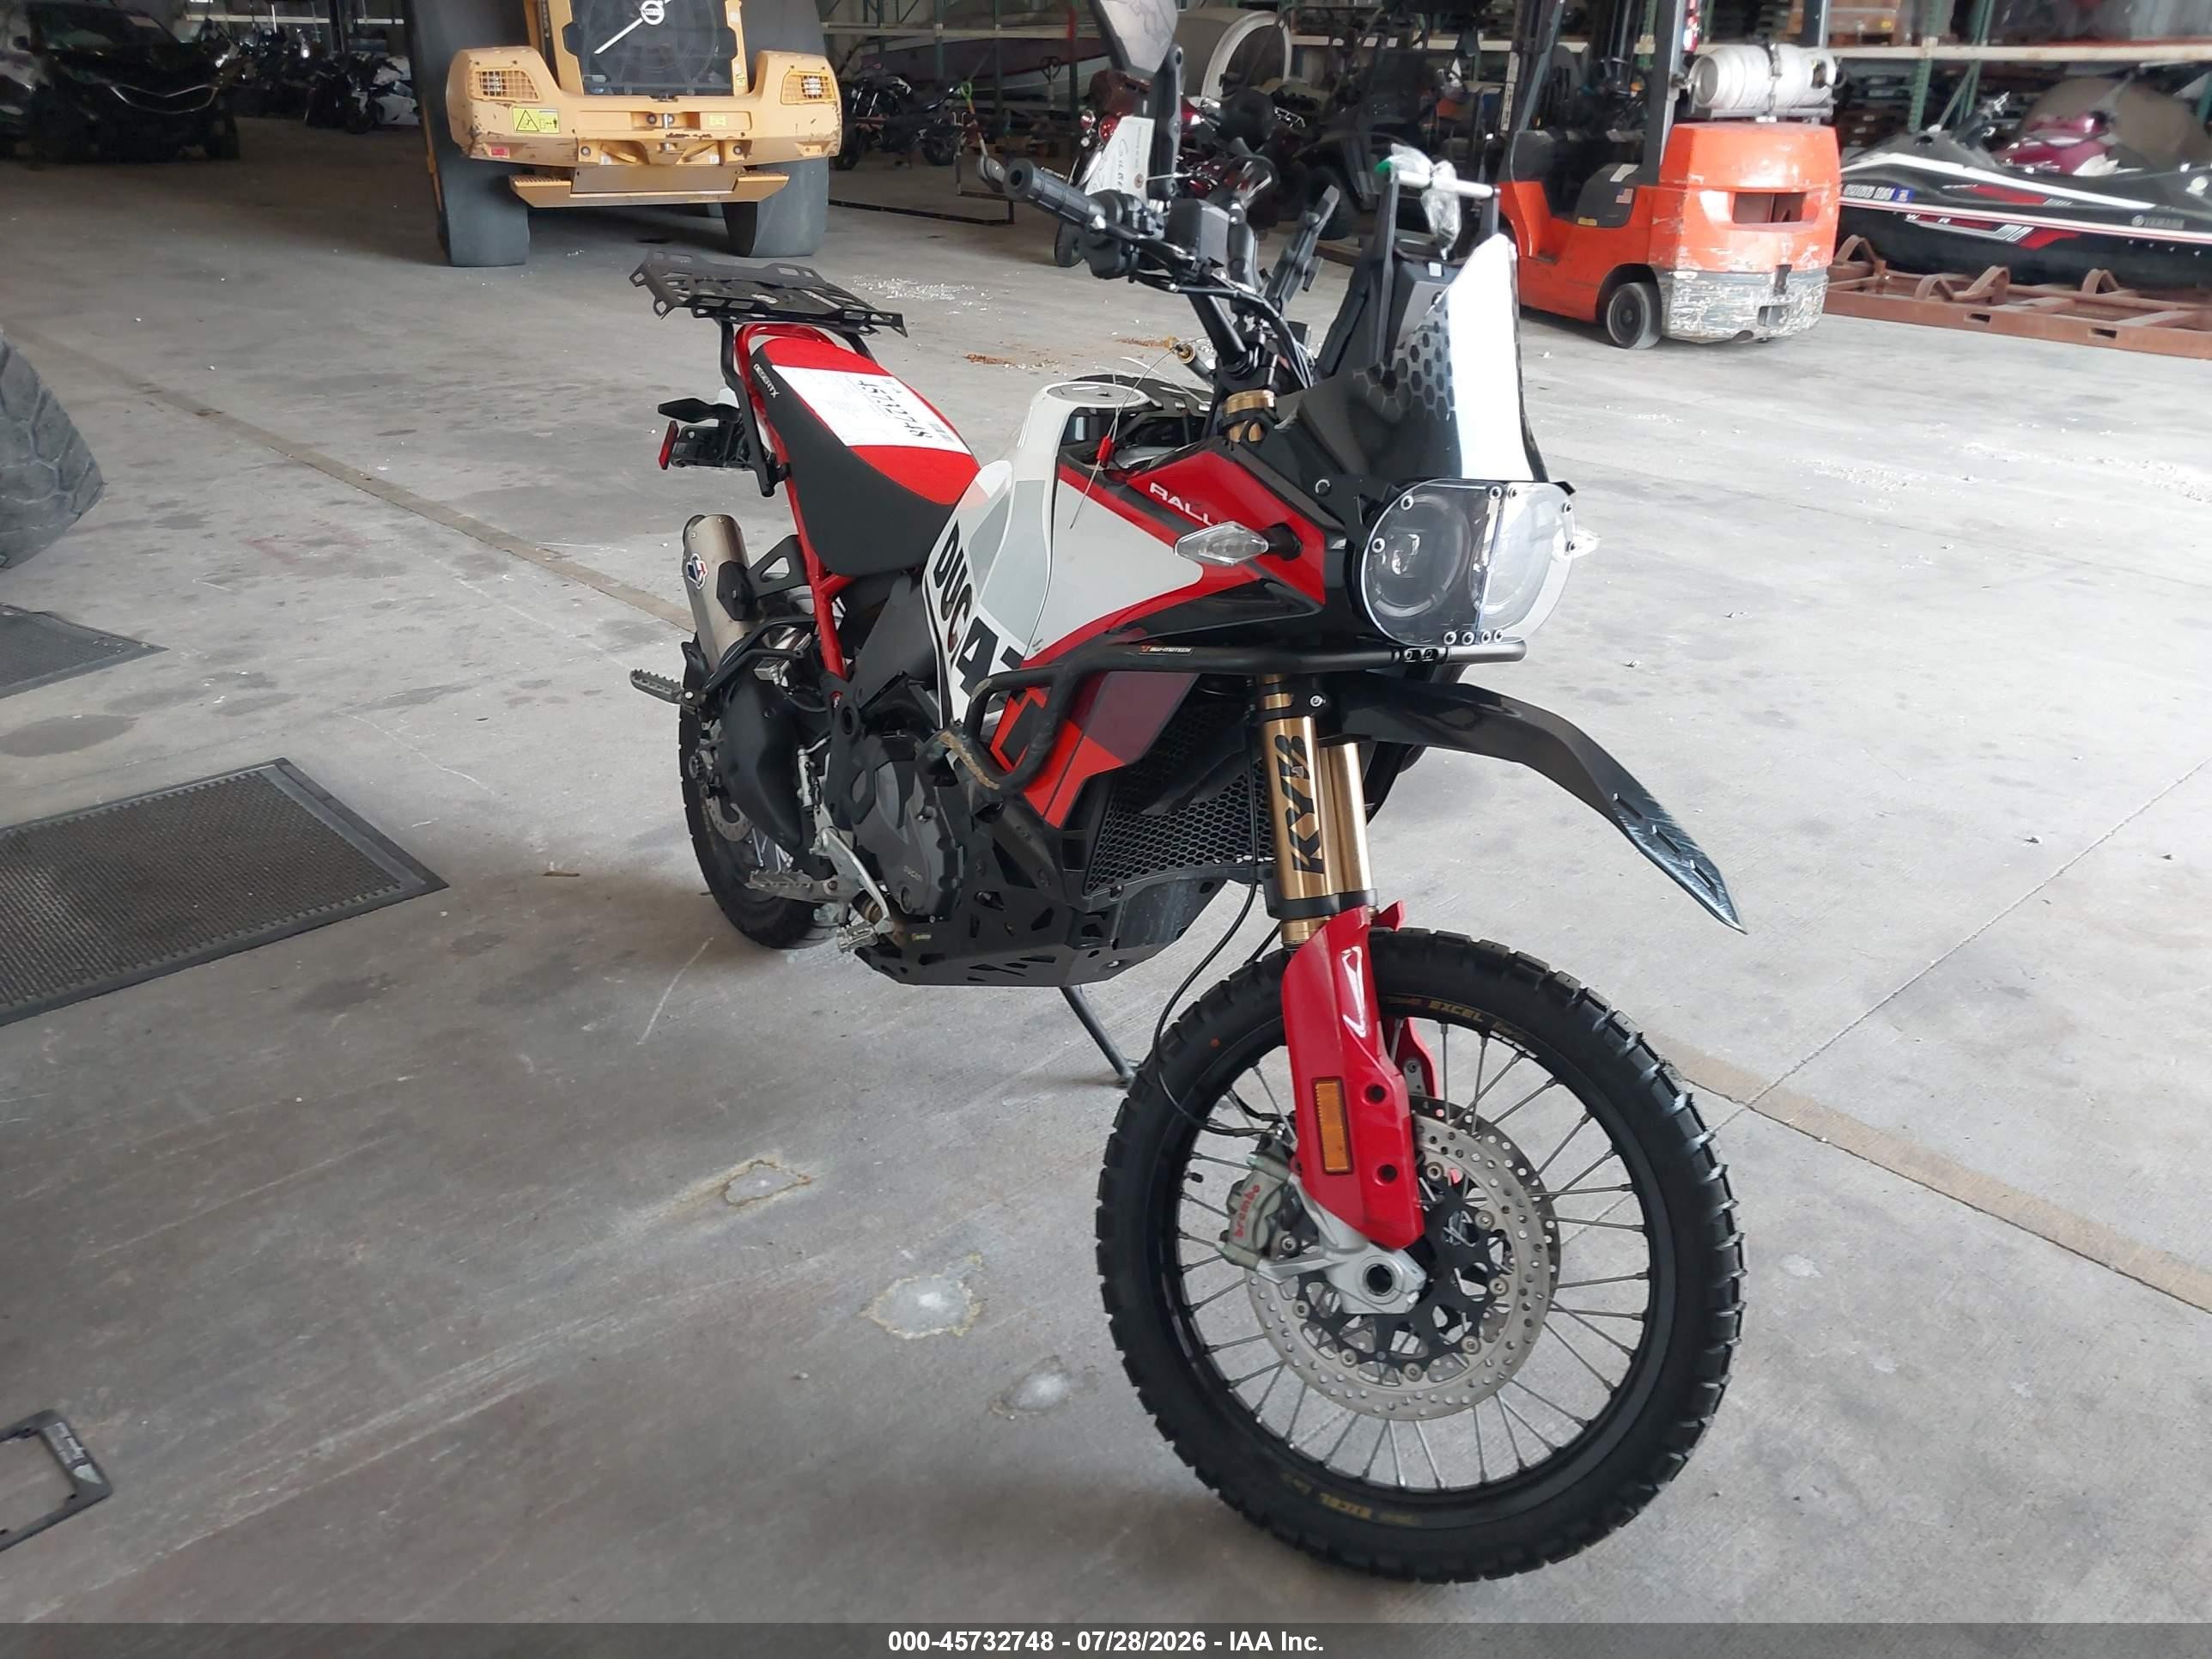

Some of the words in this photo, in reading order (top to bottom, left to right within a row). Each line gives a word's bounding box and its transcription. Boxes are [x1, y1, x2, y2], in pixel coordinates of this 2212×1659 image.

[858, 380, 933, 440] 45732748
[1150, 482, 1217, 526] RALL
[1274, 734, 1325, 874] KYB
[1429, 1000, 1485, 1024] EXCEL
[1234, 1184, 1261, 1237] brembo
